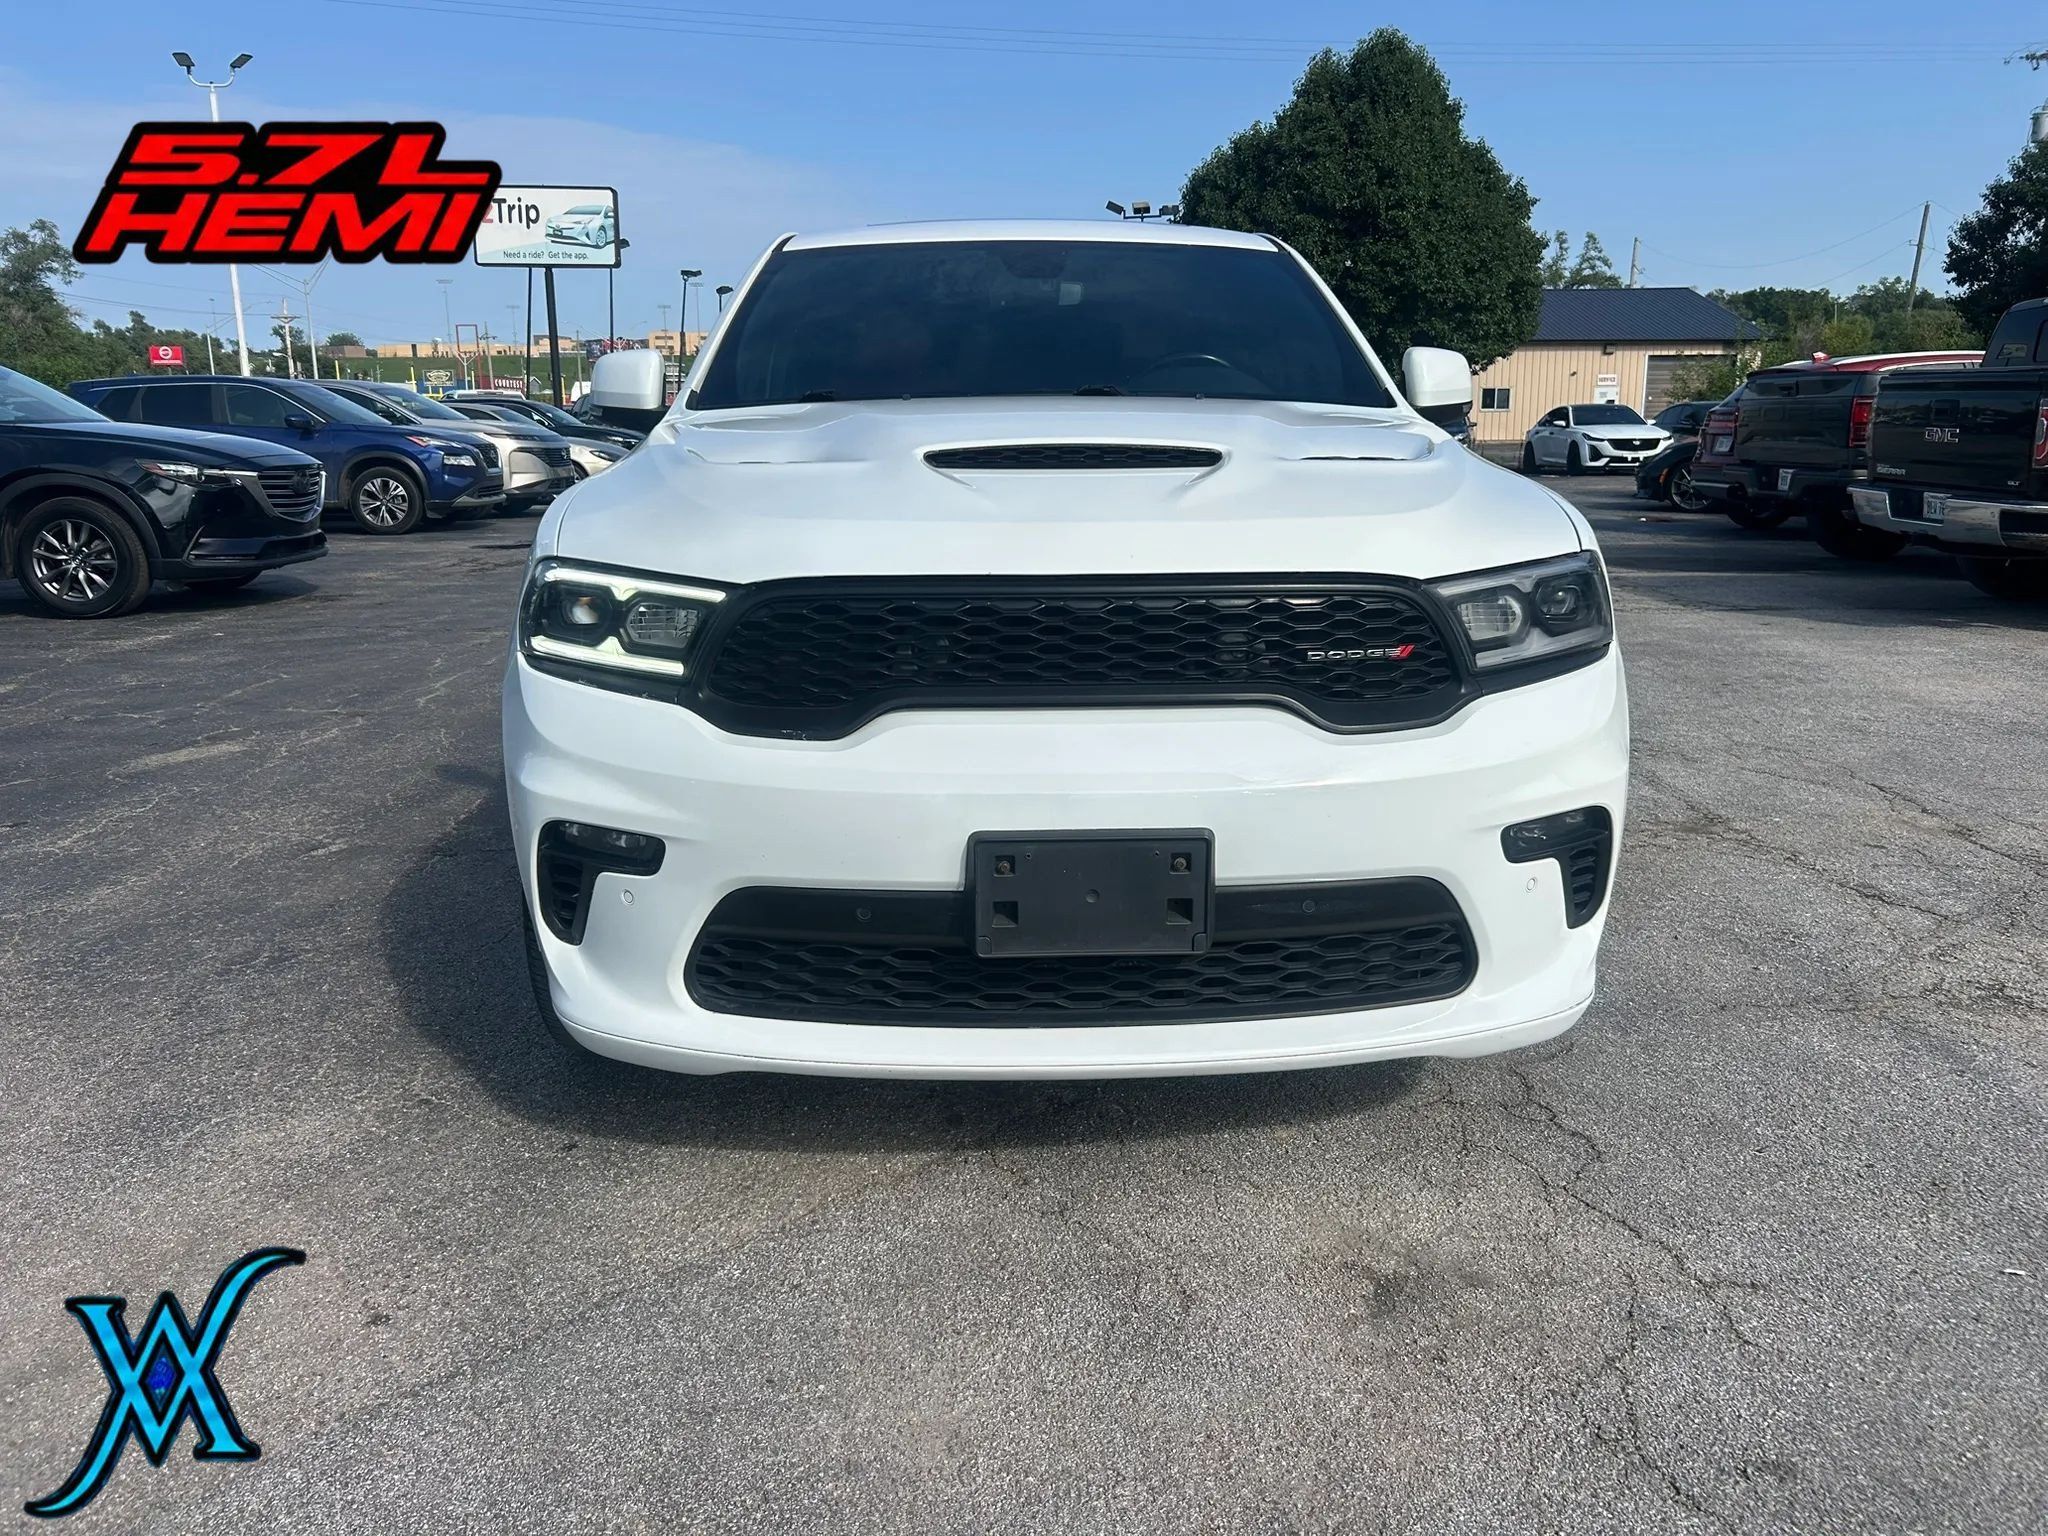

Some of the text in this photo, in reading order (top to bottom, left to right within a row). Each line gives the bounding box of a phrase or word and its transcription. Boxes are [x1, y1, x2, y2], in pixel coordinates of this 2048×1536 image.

[503, 251, 521, 259] Need
[528, 251, 545, 259] ride?
[548, 251, 560, 259] Get
[561, 251, 573, 259] the
[574, 252, 589, 260] app.
[1924, 427, 1960, 443] GMC
[1307, 647, 1403, 661] DODGE
